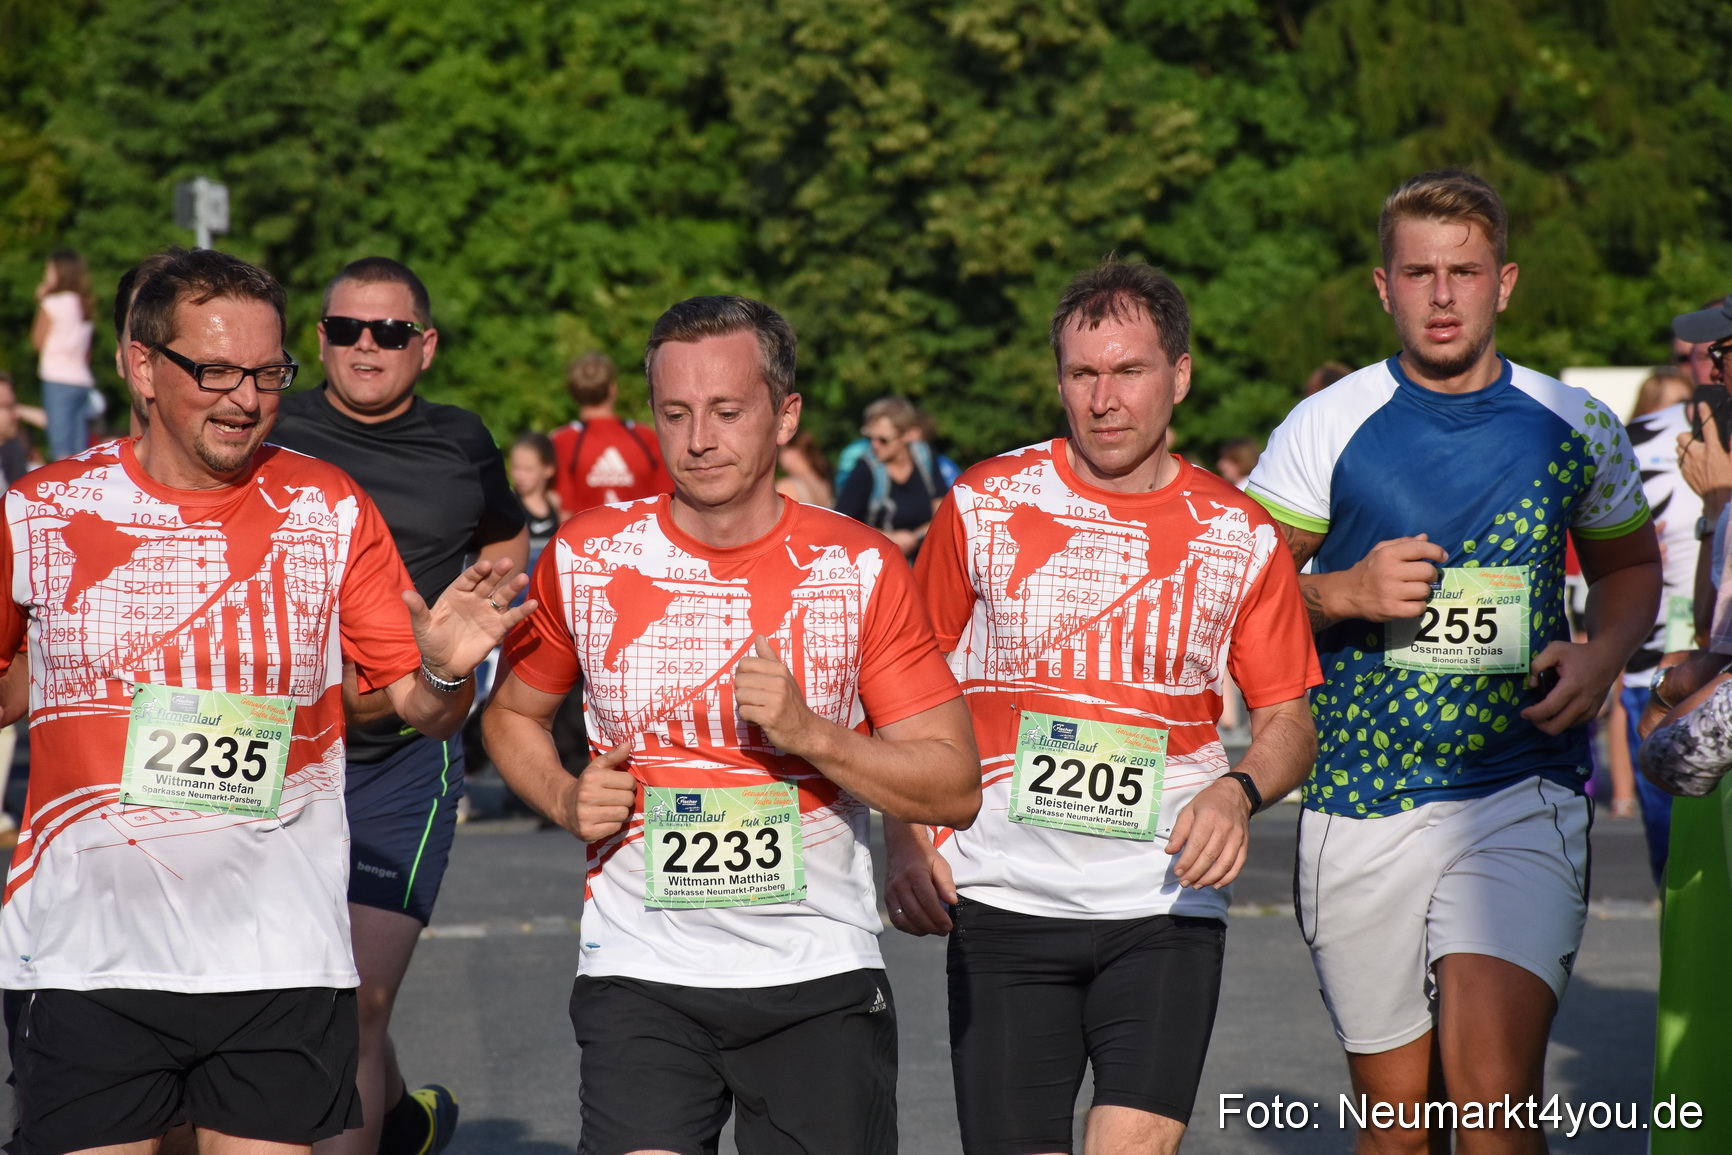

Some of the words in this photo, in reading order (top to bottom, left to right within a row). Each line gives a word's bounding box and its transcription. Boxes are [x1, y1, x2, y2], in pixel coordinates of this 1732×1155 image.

[288, 512, 338, 527] 91.62%
[1065, 505, 1107, 520] 10.54
[130, 513, 178, 527] 10.54
[1207, 528, 1254, 547] 91.62%
[1060, 546, 1105, 559] 24.87
[124, 557, 175, 571] 24.87
[665, 567, 707, 580] 10.54
[809, 567, 859, 581] 91.62%
[1058, 566, 1100, 582] 52.01
[124, 582, 174, 595] 52.01
[1056, 589, 1100, 605] 26.22
[1497, 595, 1521, 605] 2019
[122, 605, 174, 619] 26.22
[659, 613, 705, 626] 24.87
[1415, 607, 1498, 644] 255
[657, 637, 703, 650] 52.01
[1411, 644, 1463, 655] Ossmann
[1467, 647, 1503, 655] Tobias
[656, 661, 704, 674] 26.22
[156, 708, 223, 726] firmenlauf
[255, 729, 282, 740] 2019
[1039, 735, 1098, 753] firmenlauf
[144, 729, 269, 782] 2235
[1130, 757, 1156, 768] 2019
[155, 774, 215, 791] Wittmann
[218, 781, 254, 795] Stefan
[1028, 754, 1144, 806] 2205
[141, 785, 186, 797] Sparkasse
[187, 791, 262, 806] Neumarkt-Parsberg
[1035, 795, 1095, 813] Bleisteiner
[1098, 804, 1133, 818] Martin
[666, 811, 726, 822] firmenlauf
[764, 813, 790, 826] 2019
[1026, 806, 1065, 818] Sparkasse
[1066, 812, 1139, 829] Neumarkt-Parsberg
[662, 827, 782, 873] 2233
[668, 875, 725, 886] Wittmann
[729, 872, 780, 885] Matthias
[664, 888, 704, 897] Sparkasse
[706, 883, 786, 895] Neumarkt-Parsberg
